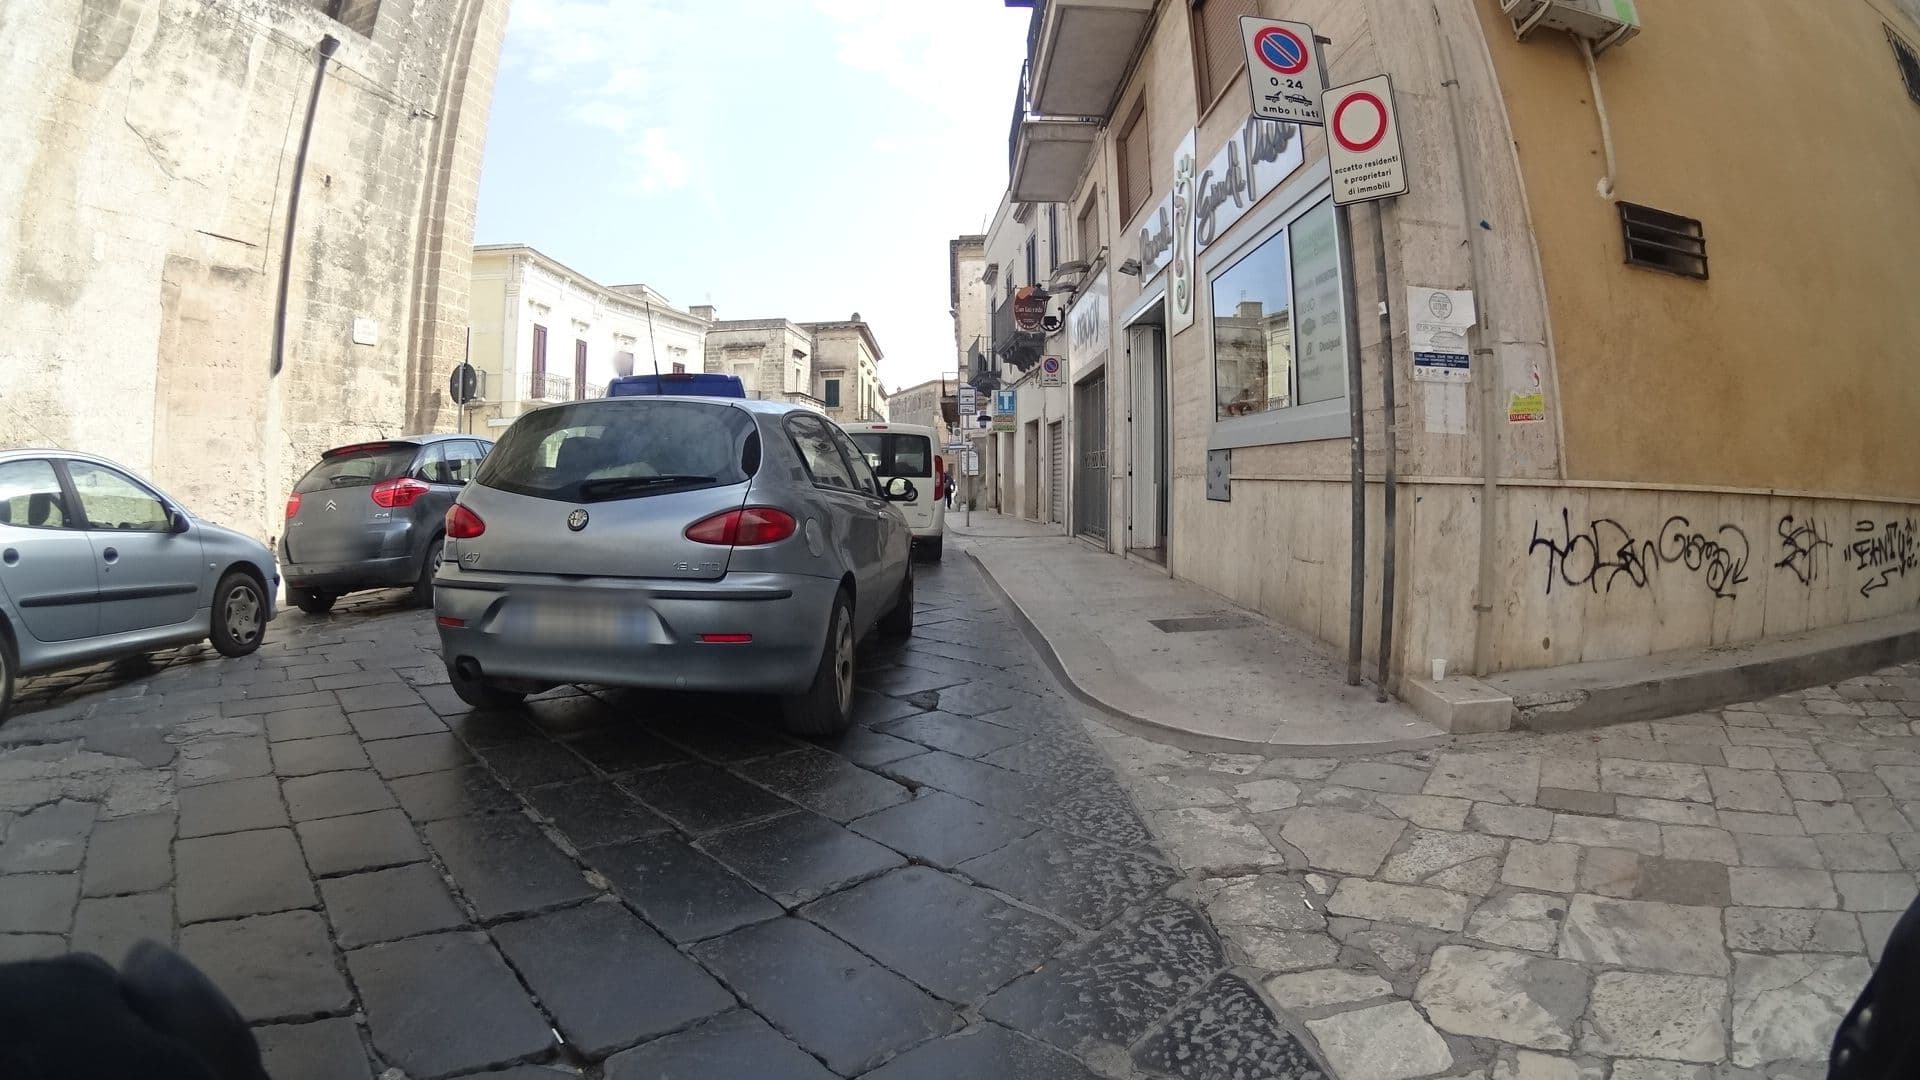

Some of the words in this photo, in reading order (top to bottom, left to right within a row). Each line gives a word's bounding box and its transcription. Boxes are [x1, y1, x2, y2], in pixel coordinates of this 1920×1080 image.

[1262, 105, 1290, 116] ambo
[1301, 109, 1320, 119] lati
[1334, 160, 1364, 175] eccetto
[1364, 155, 1399, 169] residenti
[1350, 169, 1393, 184] proprietari
[1348, 187, 1356, 196] di
[1357, 181, 1391, 194] immobili
[1001, 391, 1012, 410] T
